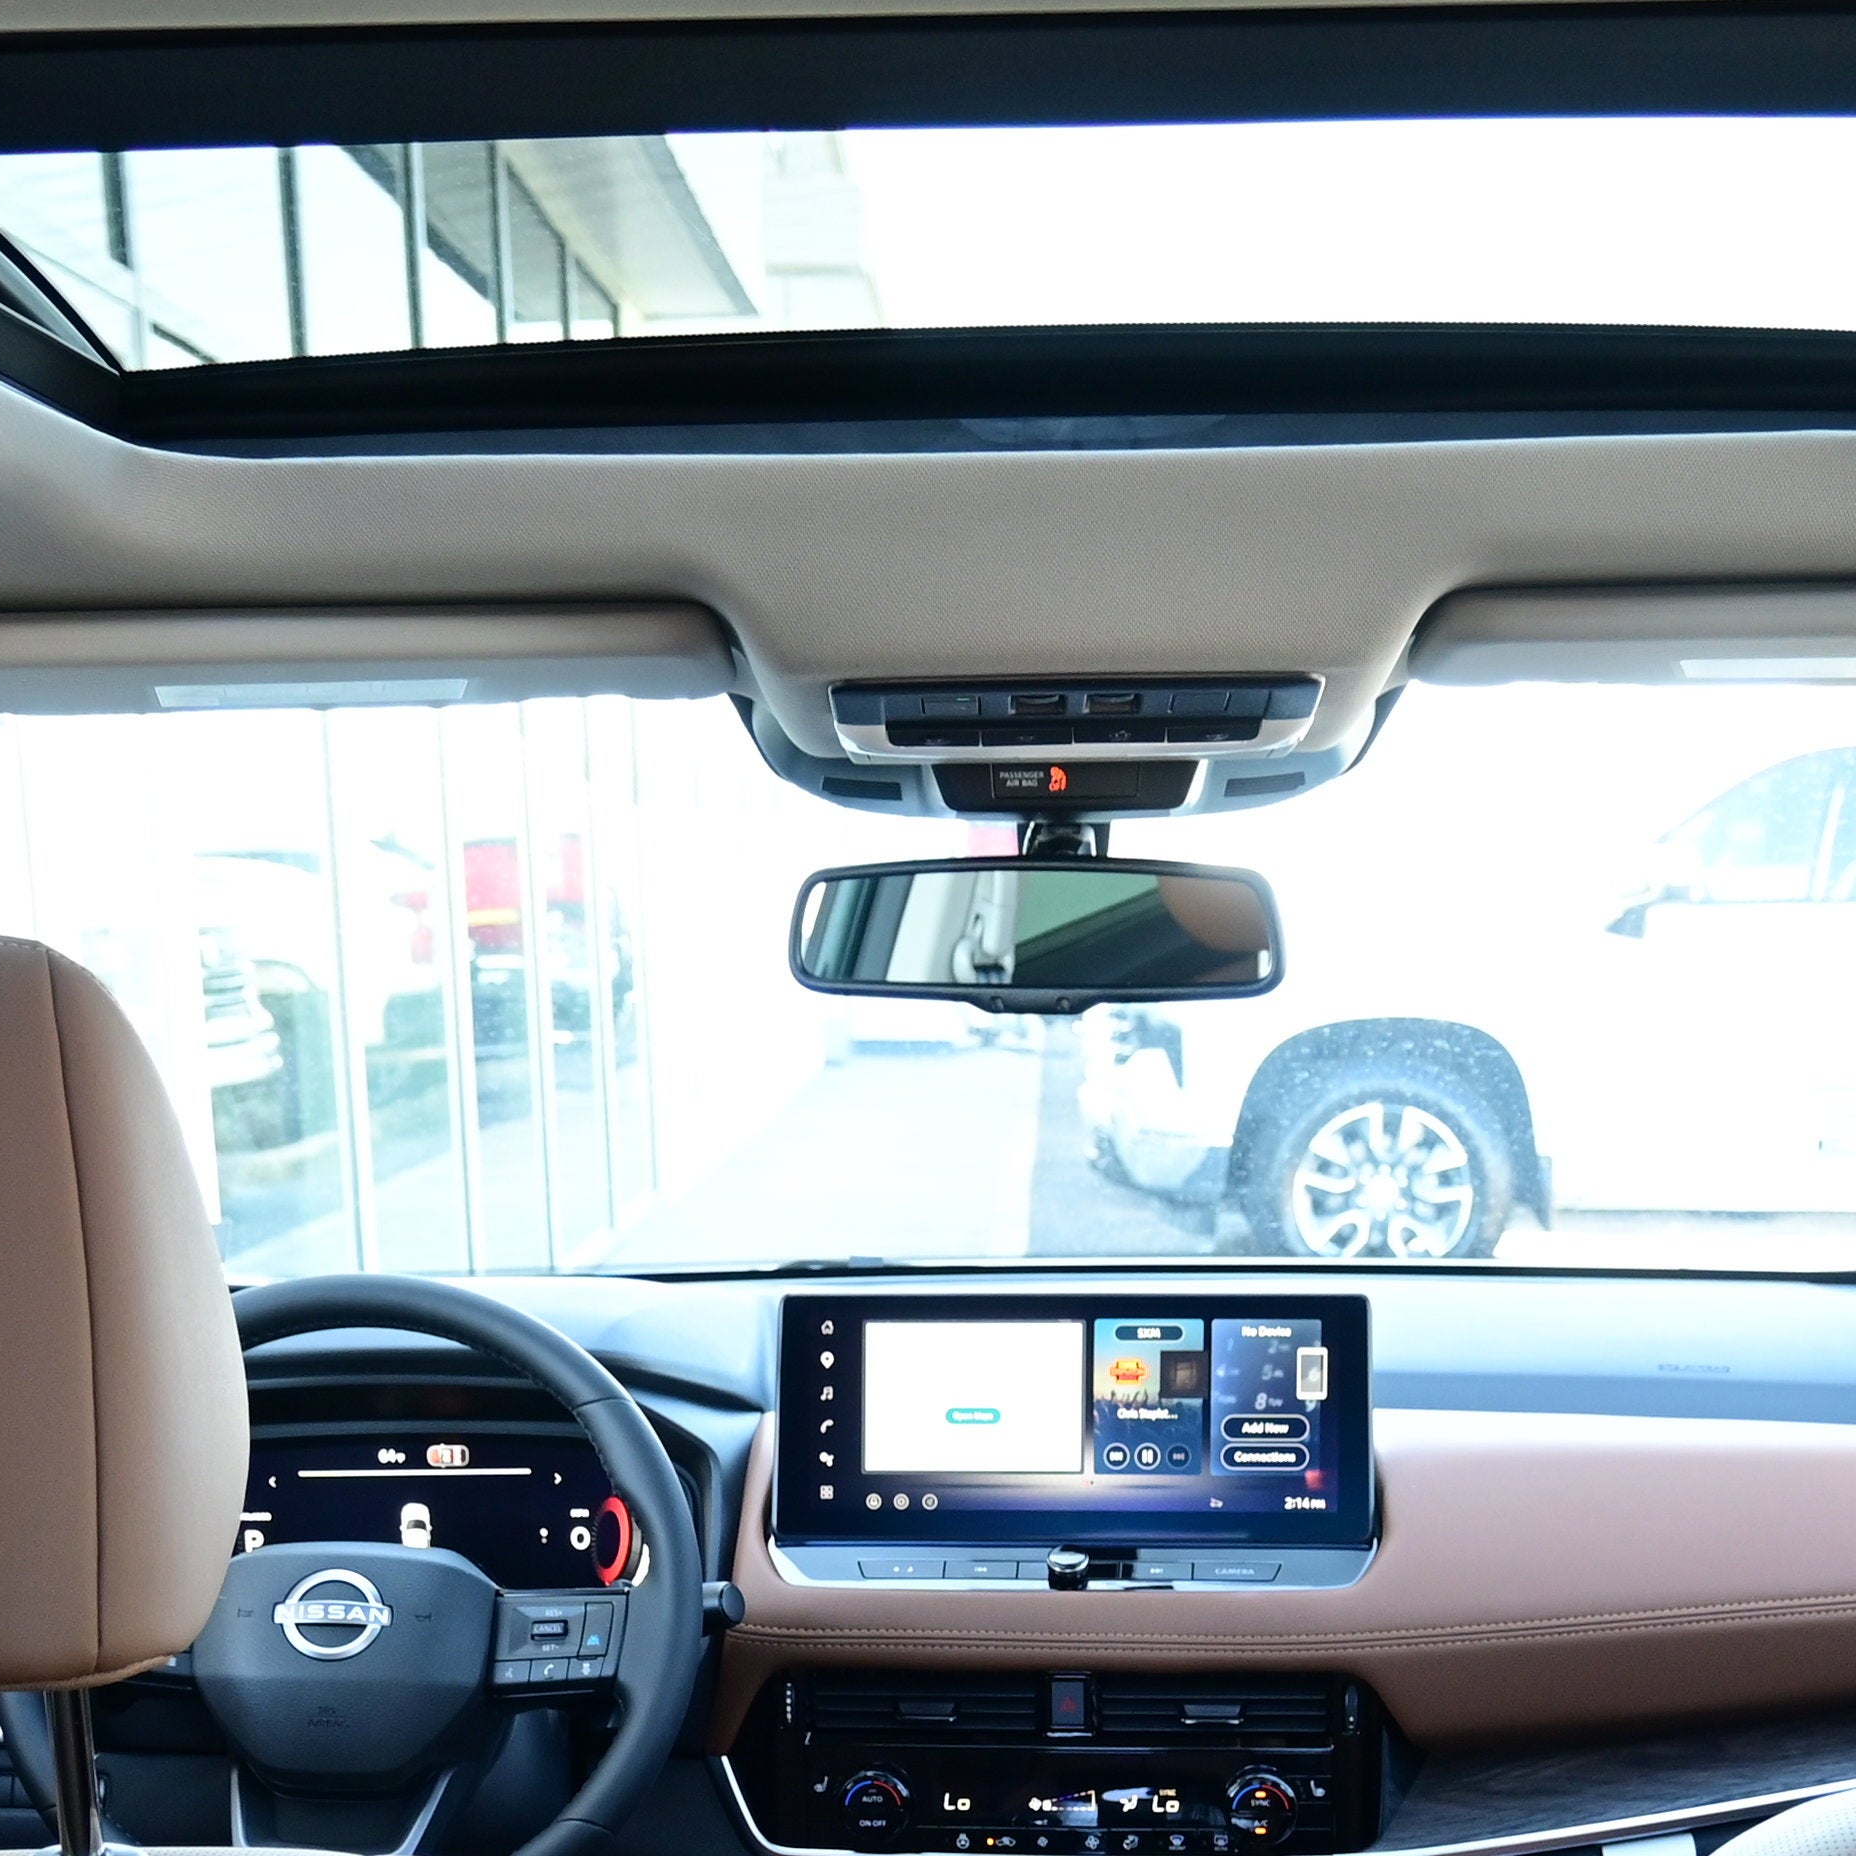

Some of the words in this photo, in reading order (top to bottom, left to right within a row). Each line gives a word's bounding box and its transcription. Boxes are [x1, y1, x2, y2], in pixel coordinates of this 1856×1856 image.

[999, 770, 1044, 779] PASSENGER
[1006, 779, 1020, 787] AIR
[1022, 779, 1038, 787] BAG
[1137, 1328, 1160, 1338] SXM
[1241, 1325, 1257, 1337] No
[1259, 1325, 1291, 1337] Device
[1242, 1422, 1263, 1434] Add
[1265, 1422, 1288, 1434] New
[1234, 1451, 1295, 1462] Connections
[1285, 1496, 1310, 1509] 2:14
[1311, 1499, 1325, 1509] PM
[245, 1530, 264, 1554] P
[1215, 1567, 1254, 1576] CAMERA
[277, 1603, 390, 1624] NISSAN
[534, 1624, 562, 1634] CANCEL
[862, 1795, 883, 1803] AUTO
[1250, 1799, 1271, 1807] SYNC
[859, 1819, 872, 1827] ON
[872, 1819, 886, 1827] OFF
[1253, 1819, 1269, 1827] A/C
